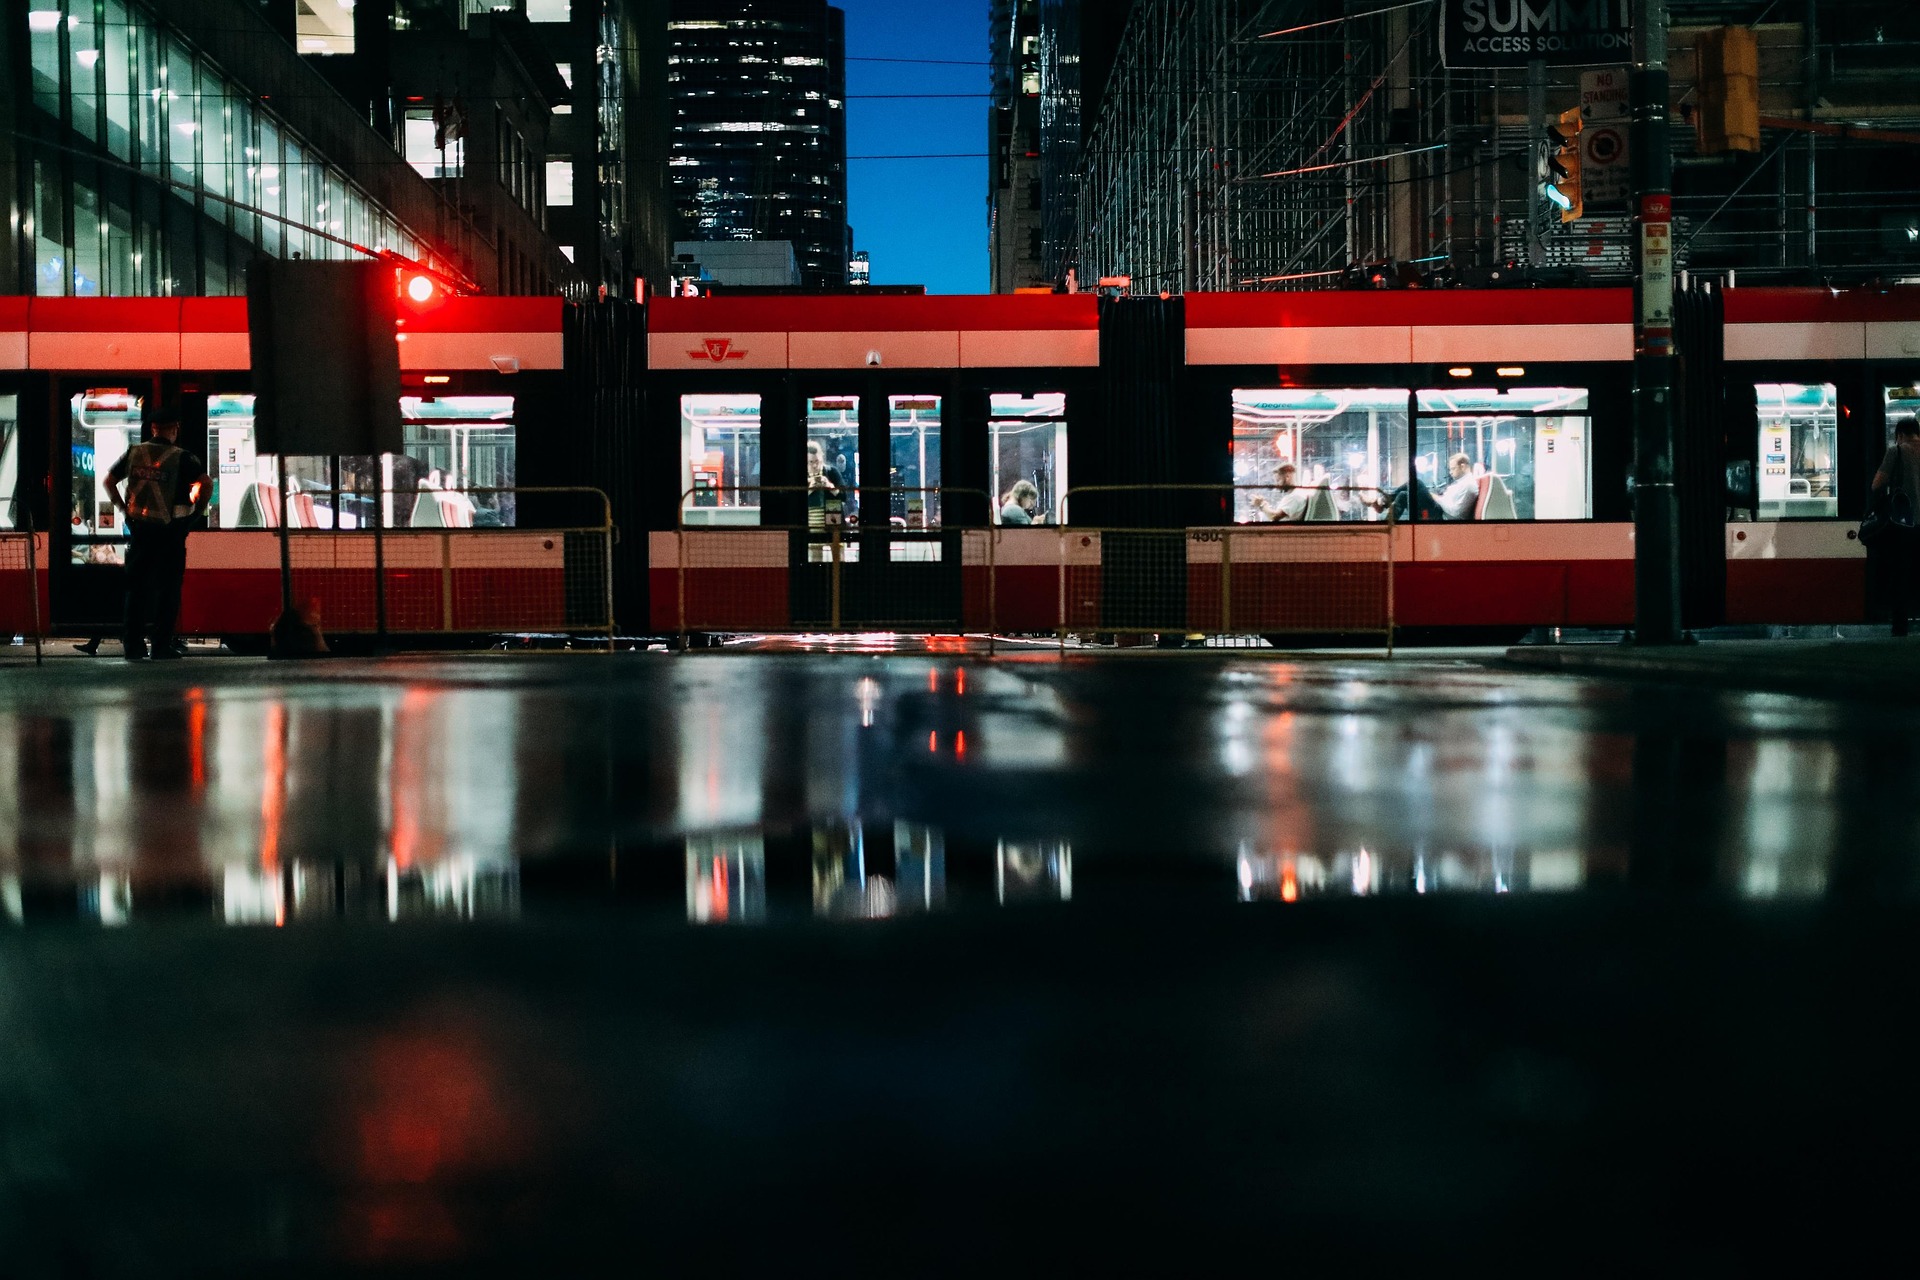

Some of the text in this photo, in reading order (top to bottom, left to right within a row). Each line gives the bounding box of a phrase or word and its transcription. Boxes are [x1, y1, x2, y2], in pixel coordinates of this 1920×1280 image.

[1464, 37, 1531, 52] ACCESS
[1597, 74, 1612, 87] NO
[1583, 88, 1628, 104] STANDING
